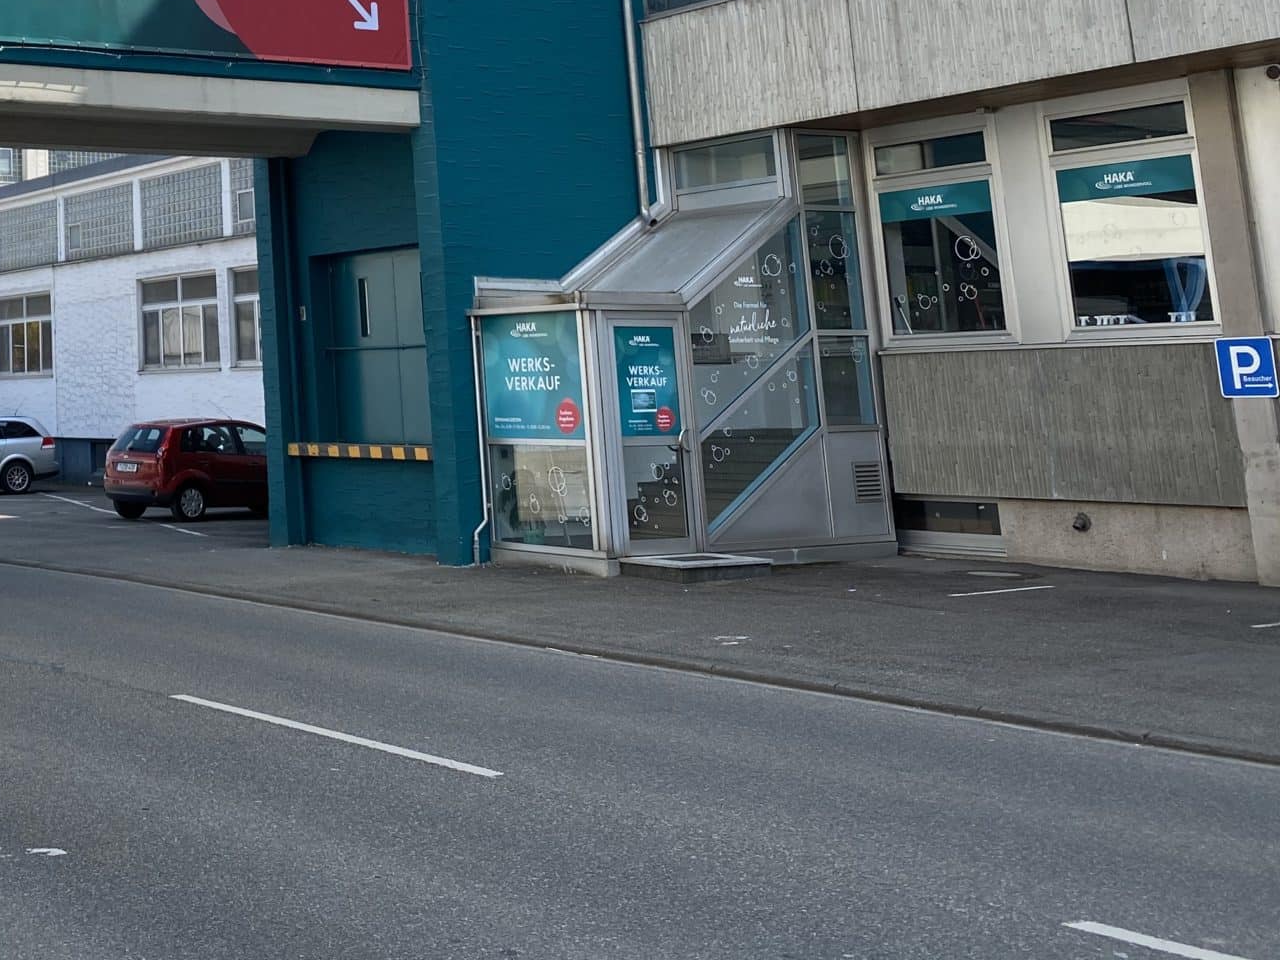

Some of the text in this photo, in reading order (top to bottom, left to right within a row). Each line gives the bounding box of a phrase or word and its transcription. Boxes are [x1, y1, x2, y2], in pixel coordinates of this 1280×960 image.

[1103, 171, 1134, 184] HAKA
[917, 194, 943, 206] HAKA
[516, 322, 537, 332] HAKA
[507, 357, 556, 373] WERKS-
[628, 365, 664, 376] WERKS-
[1229, 345, 1261, 389] P
[504, 376, 561, 391] VERKAUF
[626, 376, 668, 387] VERKAUF
